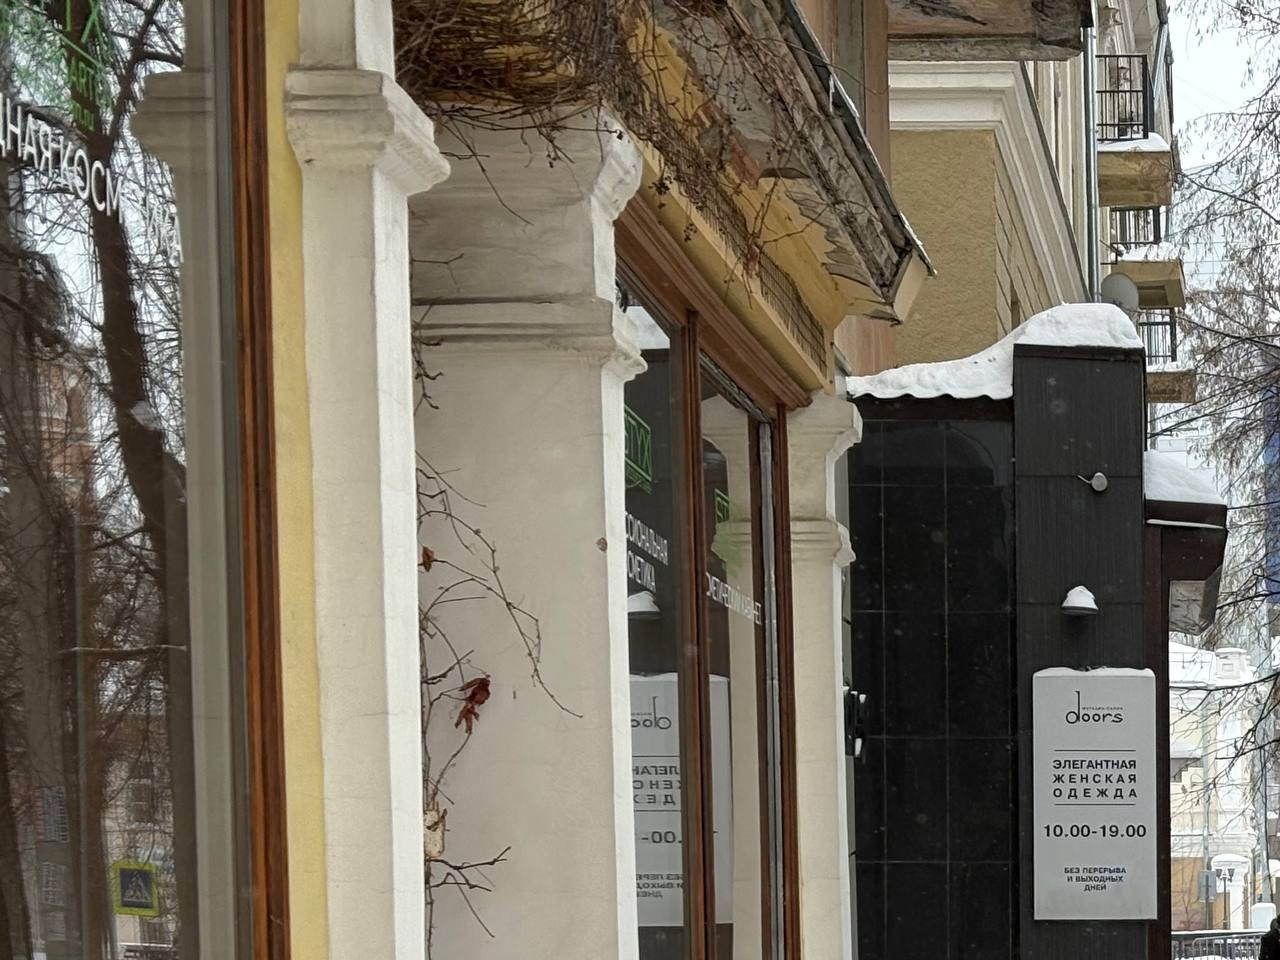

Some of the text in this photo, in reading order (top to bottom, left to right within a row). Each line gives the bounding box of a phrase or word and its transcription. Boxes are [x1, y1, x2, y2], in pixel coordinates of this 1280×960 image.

[0, 92, 52, 179] НАЯ
[1066, 690, 1123, 724] doors
[1052, 759, 1137, 770] ЭЛЕГАНТНАЯ
[1052, 774, 1137, 784] ЖЕНСКАЯ
[1052, 788, 1137, 800] ОДЕЖДА
[1043, 824, 1147, 838] 10.00-19.00
[1063, 866, 1127, 874] БЕЗ ПЕРЕРЫВА
[1066, 875, 1124, 883] И ВЫХОДНЫХ
[1083, 883, 1107, 892] ДНЕЙ
